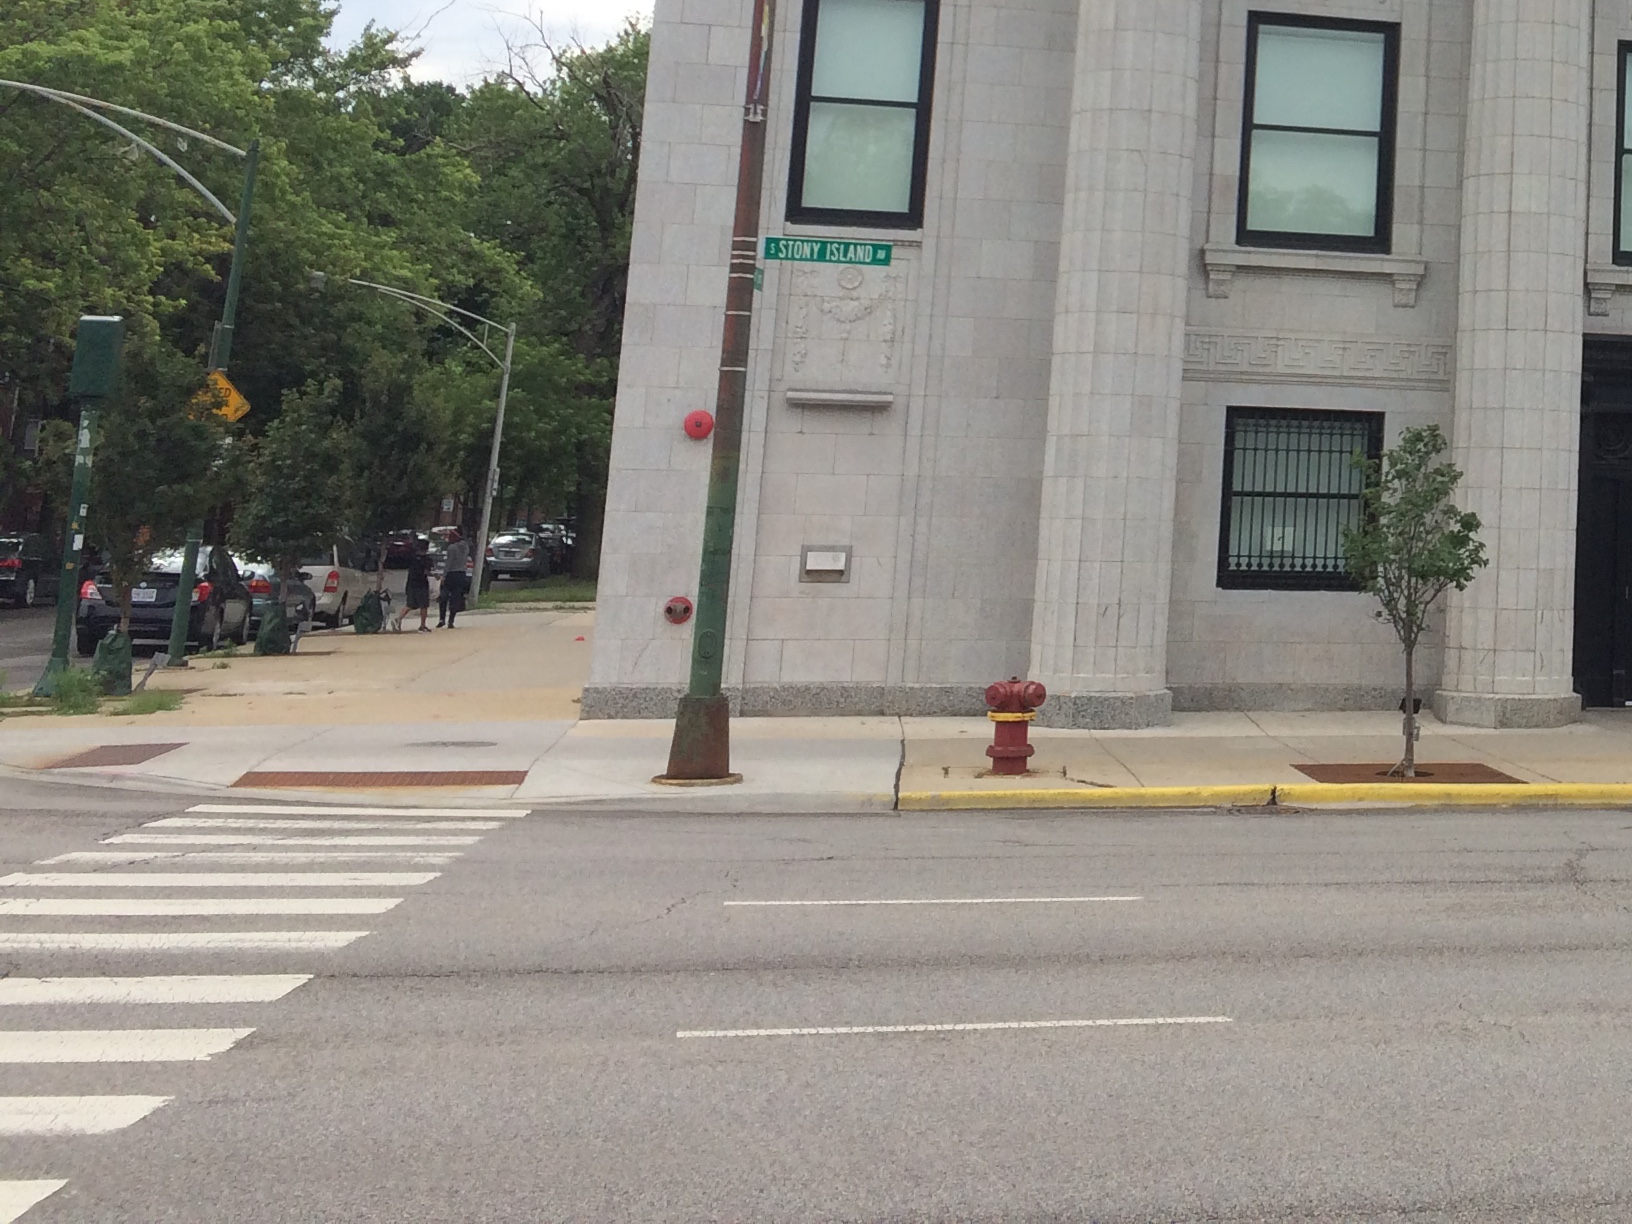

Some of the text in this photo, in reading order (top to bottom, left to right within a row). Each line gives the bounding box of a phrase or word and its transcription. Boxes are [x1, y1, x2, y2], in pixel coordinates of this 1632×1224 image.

[769, 243, 776, 254] S
[777, 239, 821, 260] STONY
[825, 242, 874, 263] ISLAND
